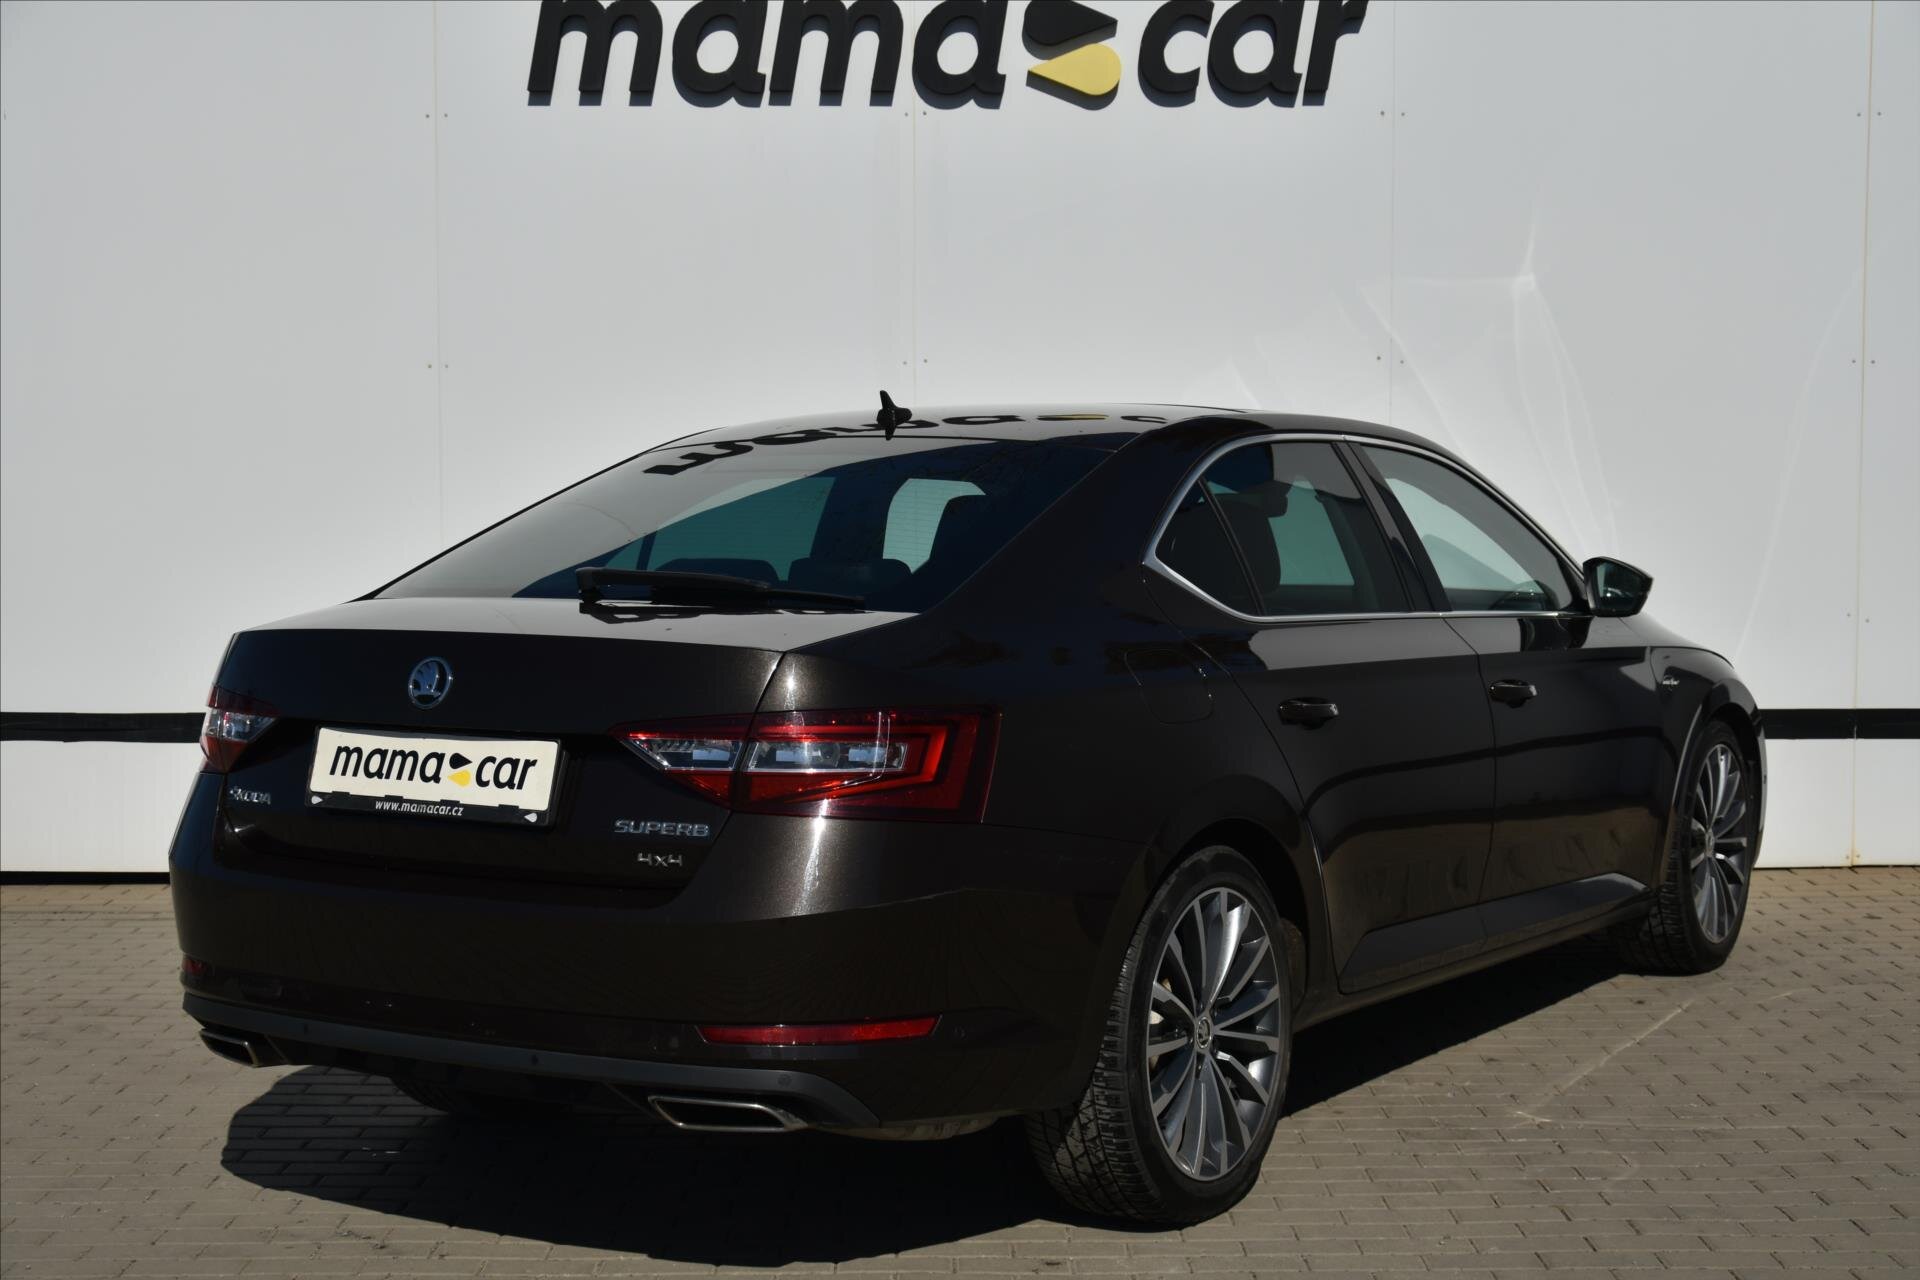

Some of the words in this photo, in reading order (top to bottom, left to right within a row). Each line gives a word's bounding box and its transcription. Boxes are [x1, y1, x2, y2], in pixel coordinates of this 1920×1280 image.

[527, 0, 1007, 110] mama
[1138, 0, 1369, 109] car
[329, 745, 446, 784] mama
[475, 755, 538, 790] car
[375, 800, 464, 817] www.mamacar.cz
[614, 819, 710, 837] SUPERB
